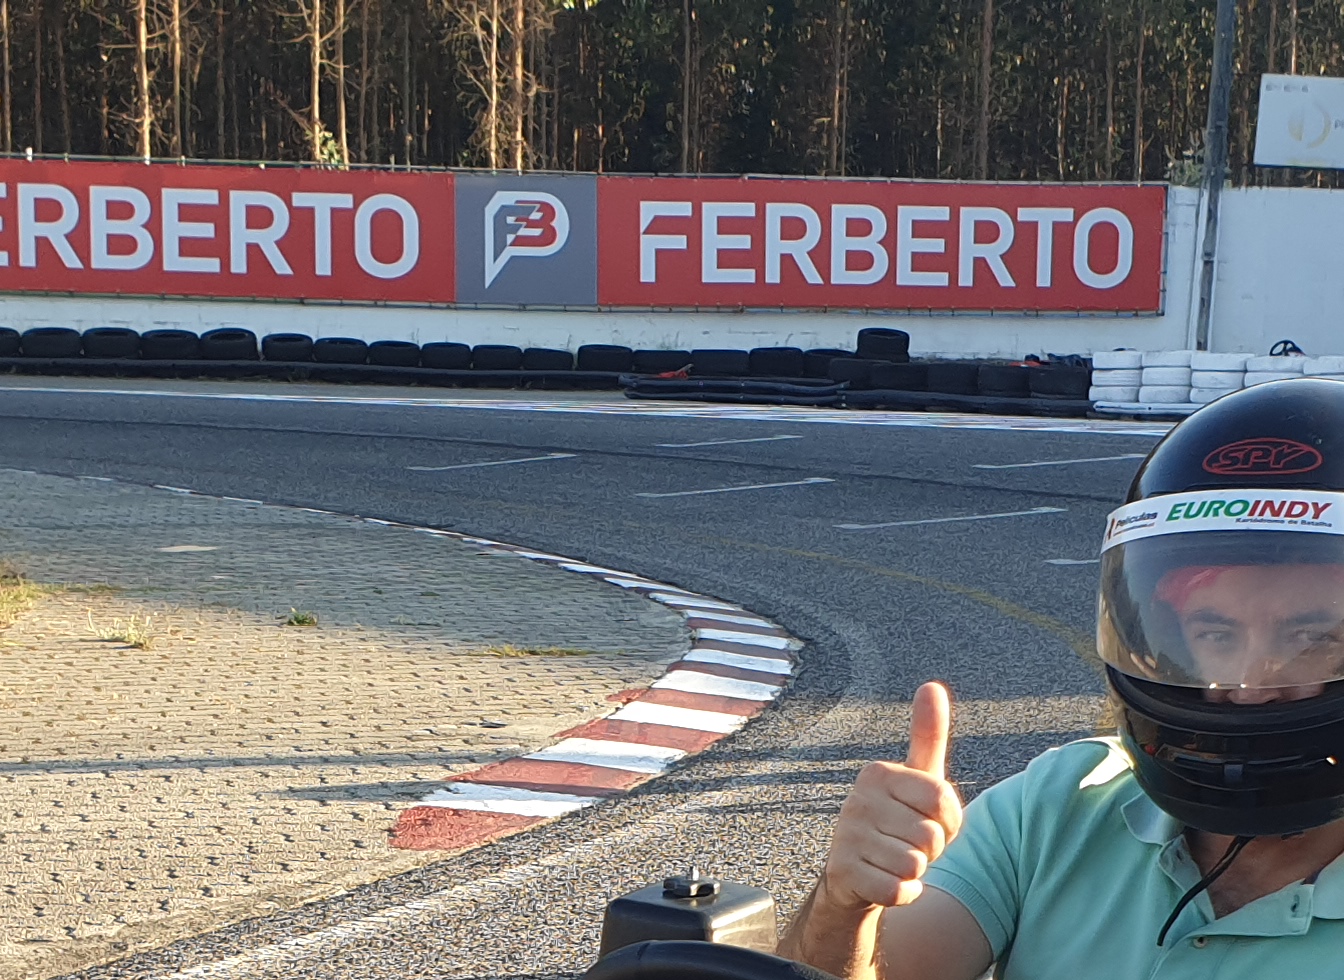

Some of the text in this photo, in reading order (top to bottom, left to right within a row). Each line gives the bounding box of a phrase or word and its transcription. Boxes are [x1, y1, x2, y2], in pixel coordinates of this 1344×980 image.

[639, 200, 1134, 289] FERBERTO
[1212, 444, 1311, 469] SPY
[1165, 499, 1333, 522] EUROINDY
